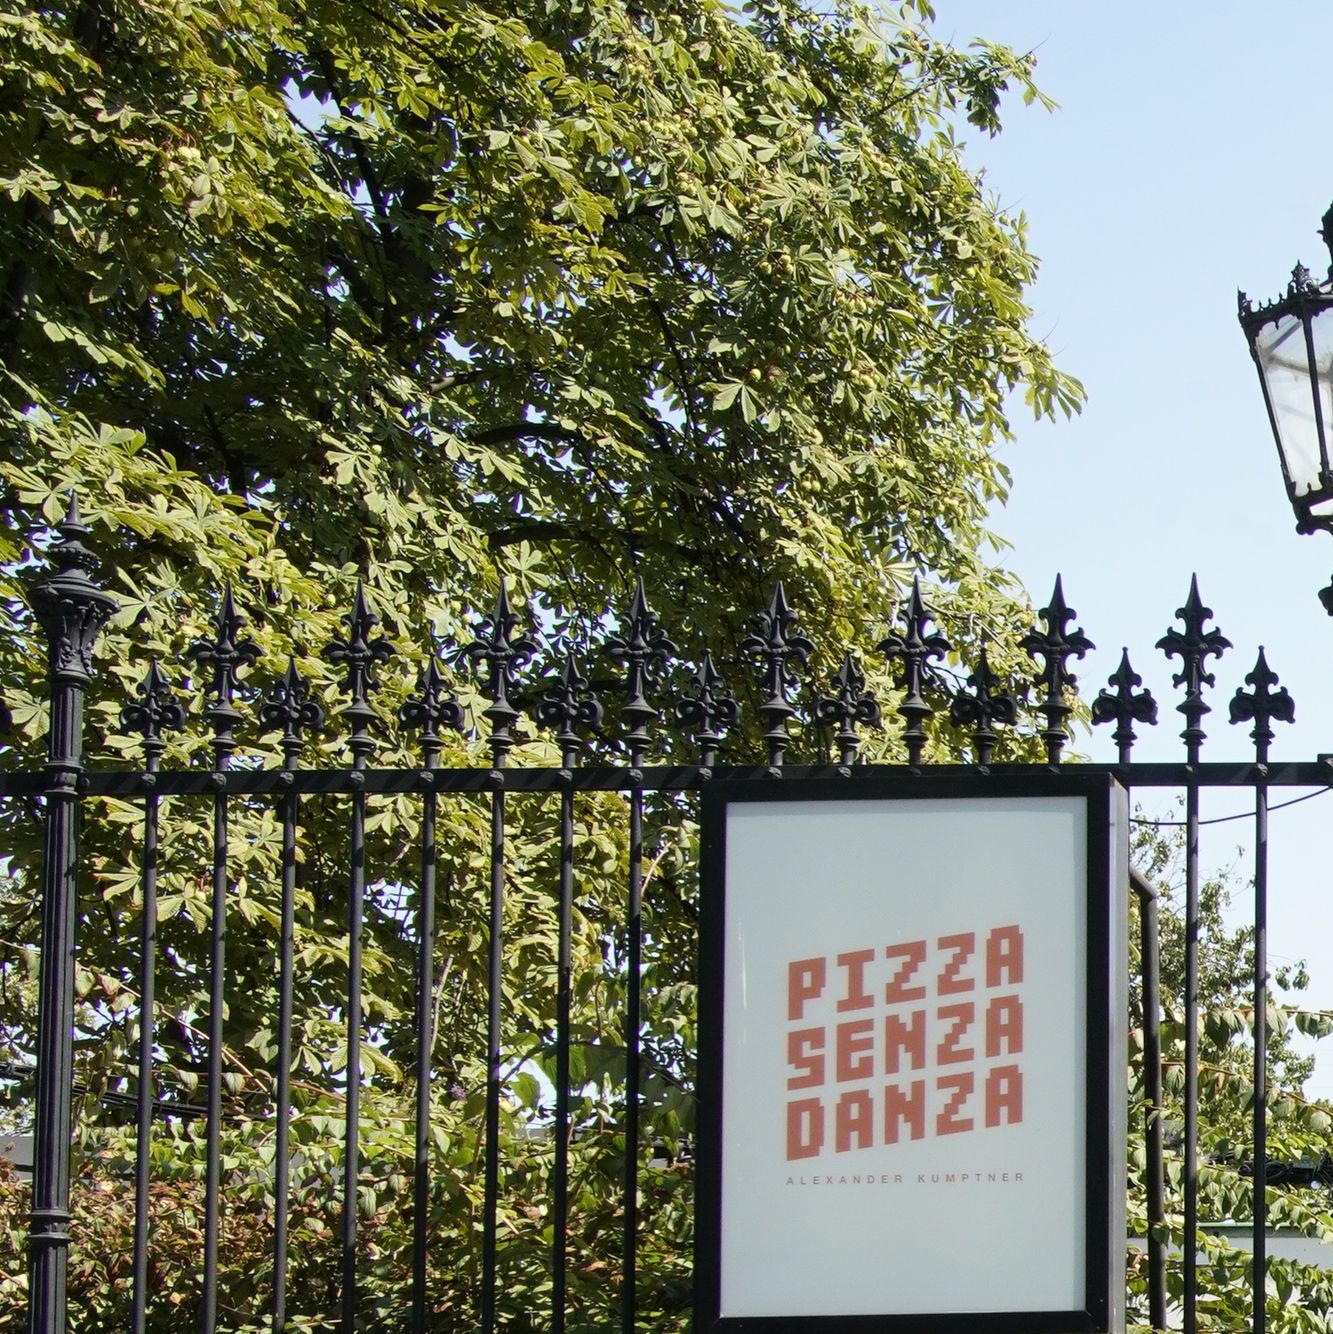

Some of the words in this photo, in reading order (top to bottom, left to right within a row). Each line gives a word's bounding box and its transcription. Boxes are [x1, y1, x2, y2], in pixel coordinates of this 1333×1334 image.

[787, 924, 1024, 1021] PIZZA
[786, 994, 1023, 1091] SENZA
[785, 1064, 1023, 1161] DANZA
[786, 1174, 903, 1186] ALEXANDER
[917, 1172, 1024, 1184] KUMPTNER
